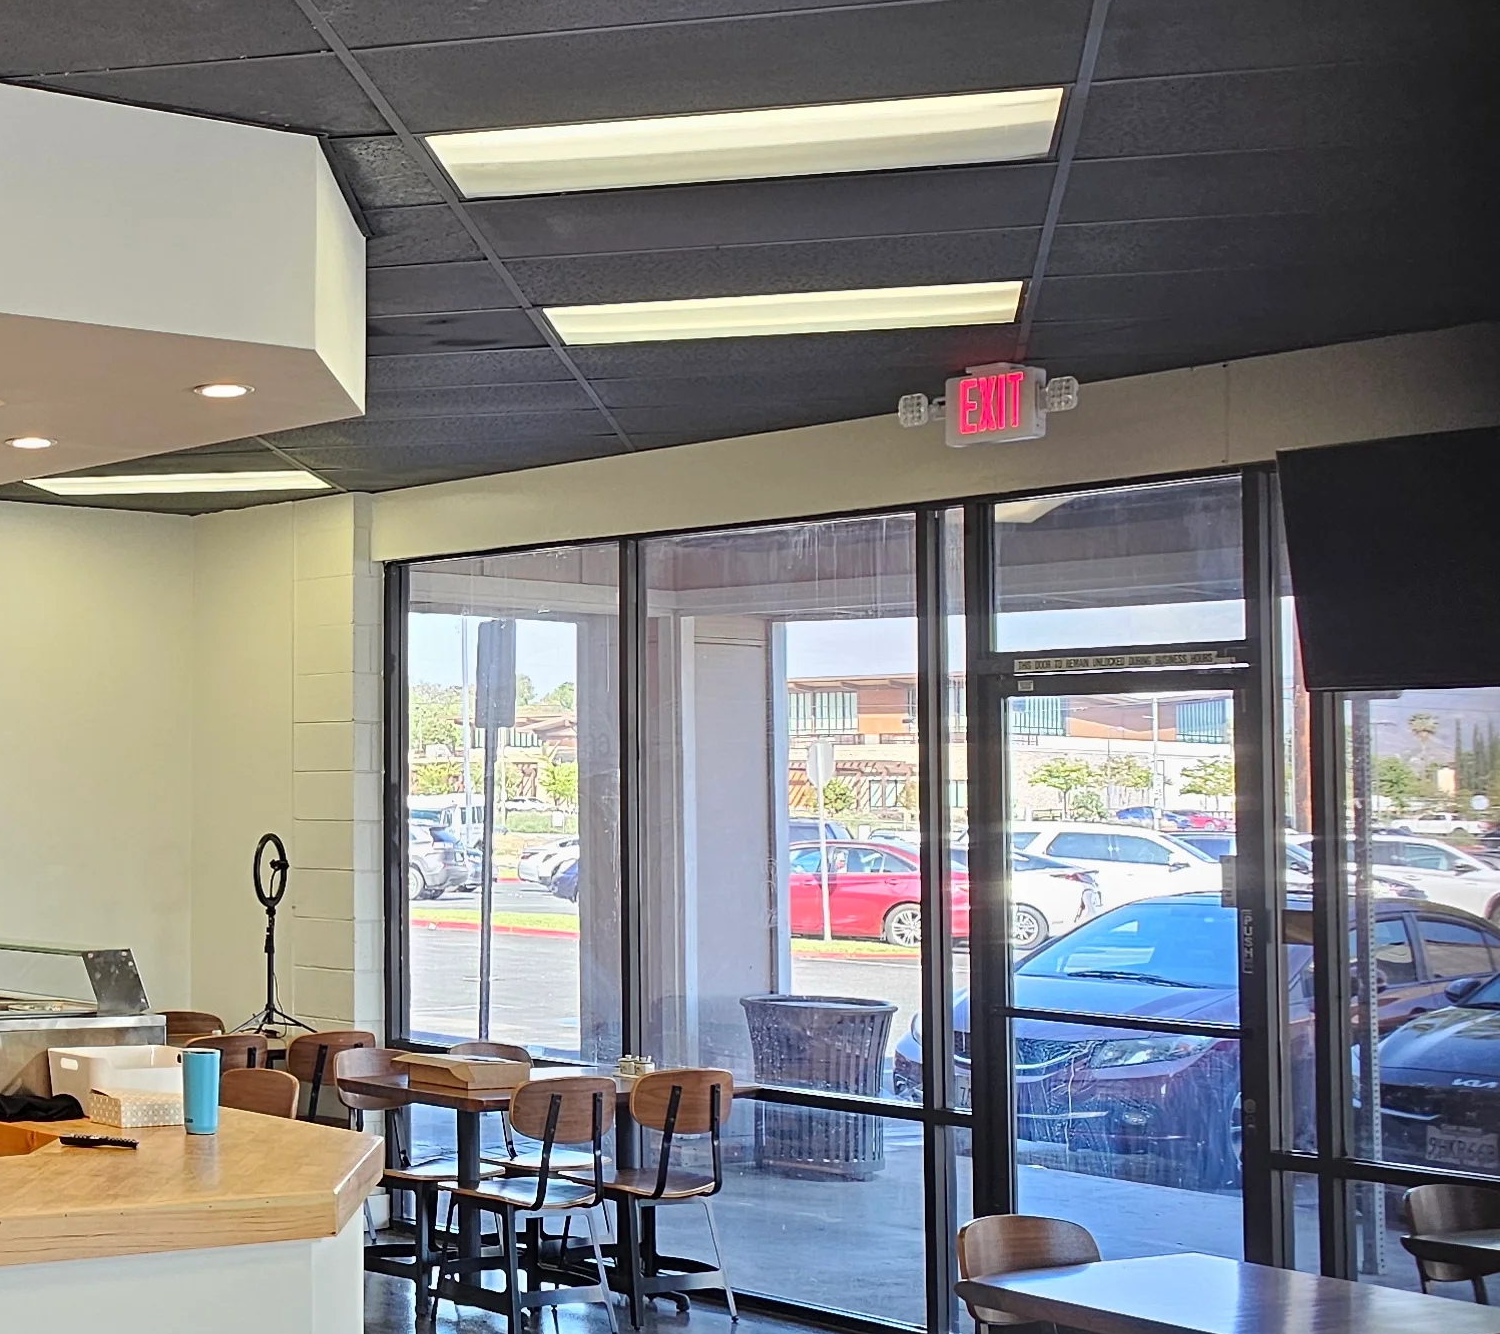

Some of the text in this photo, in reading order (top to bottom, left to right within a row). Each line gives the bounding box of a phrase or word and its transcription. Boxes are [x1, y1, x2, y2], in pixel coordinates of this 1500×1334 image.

[959, 371, 1024, 434] EXIT
[1017, 653, 1213, 670] THIS DOOR TO REMAIN UNLOCKED DURING BUSINESS HOURS
[1243, 915, 1253, 958] PUSH
